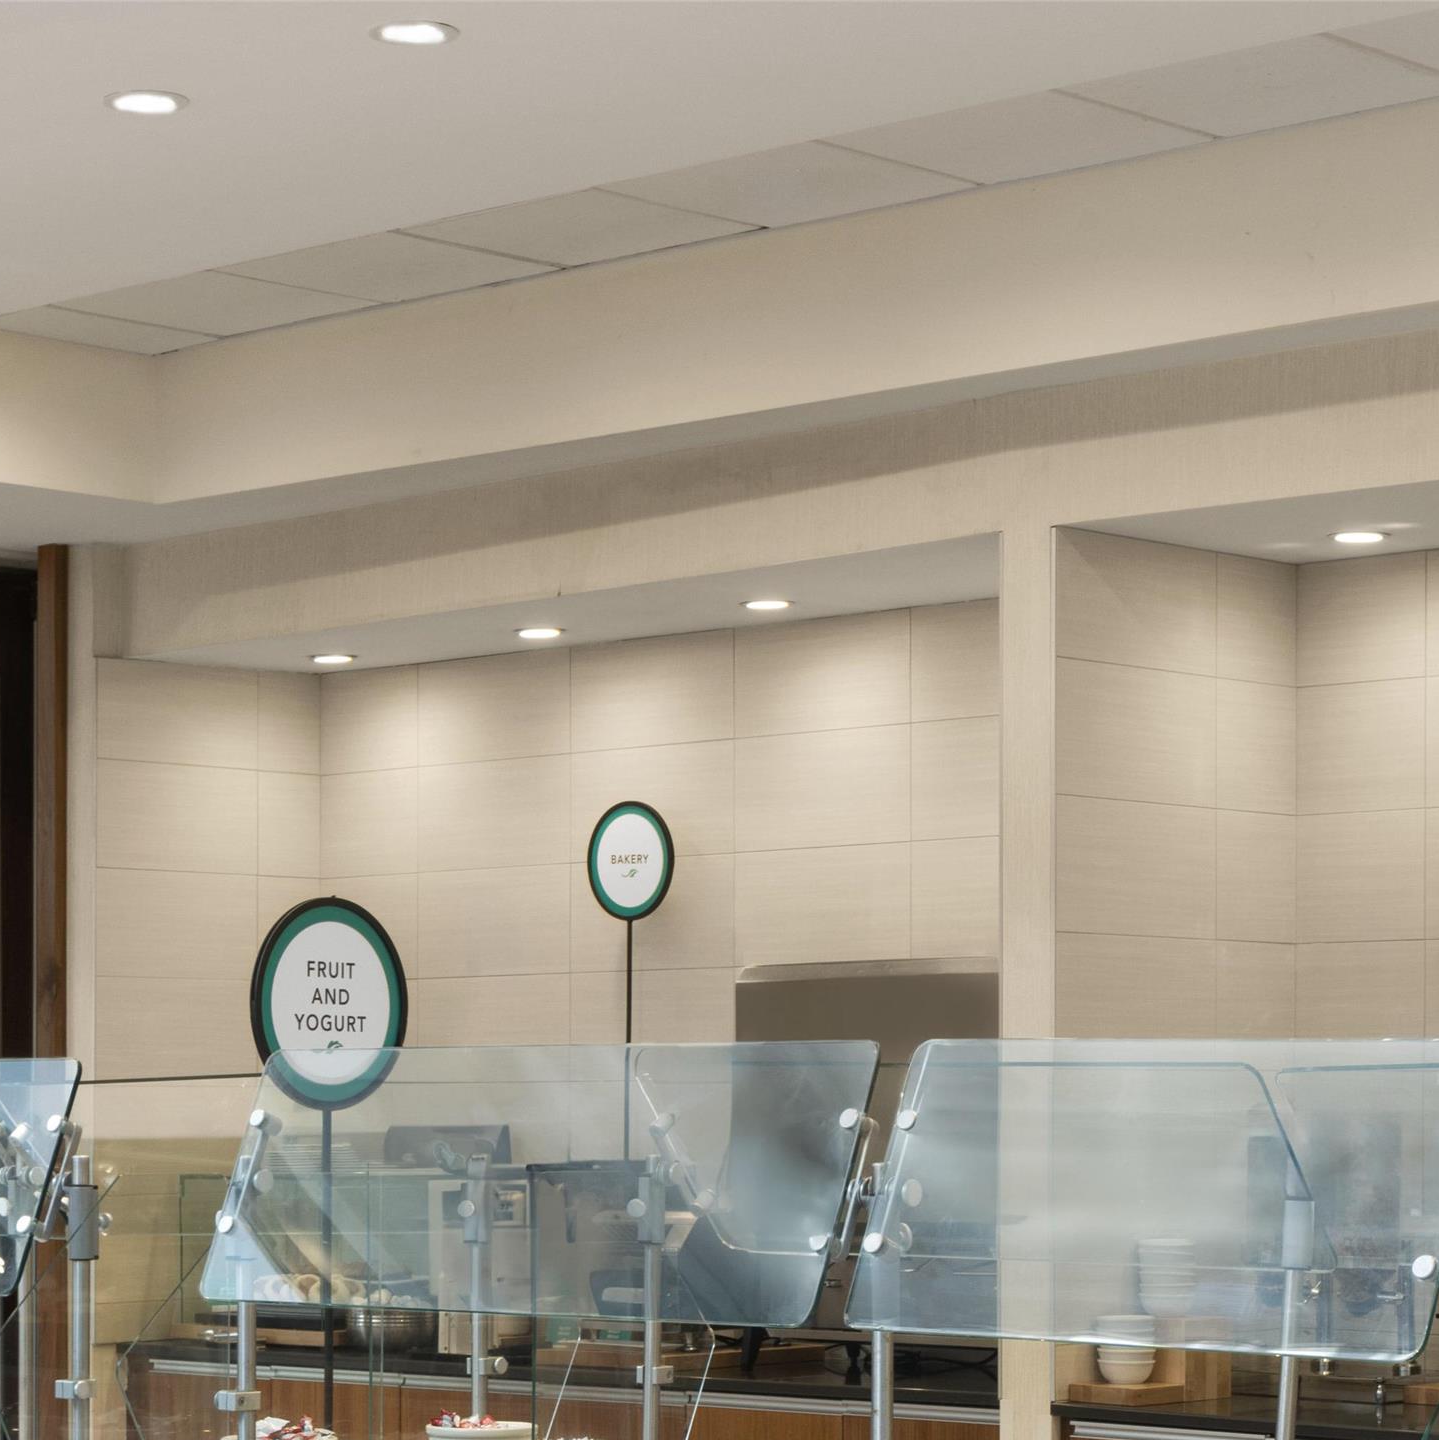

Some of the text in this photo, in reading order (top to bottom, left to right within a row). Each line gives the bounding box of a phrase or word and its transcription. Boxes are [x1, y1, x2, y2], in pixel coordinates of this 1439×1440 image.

[610, 854, 649, 865] BAKERY
[306, 960, 356, 979] FRUIT
[311, 987, 350, 1005] AND
[294, 1013, 367, 1033] YOGURT
